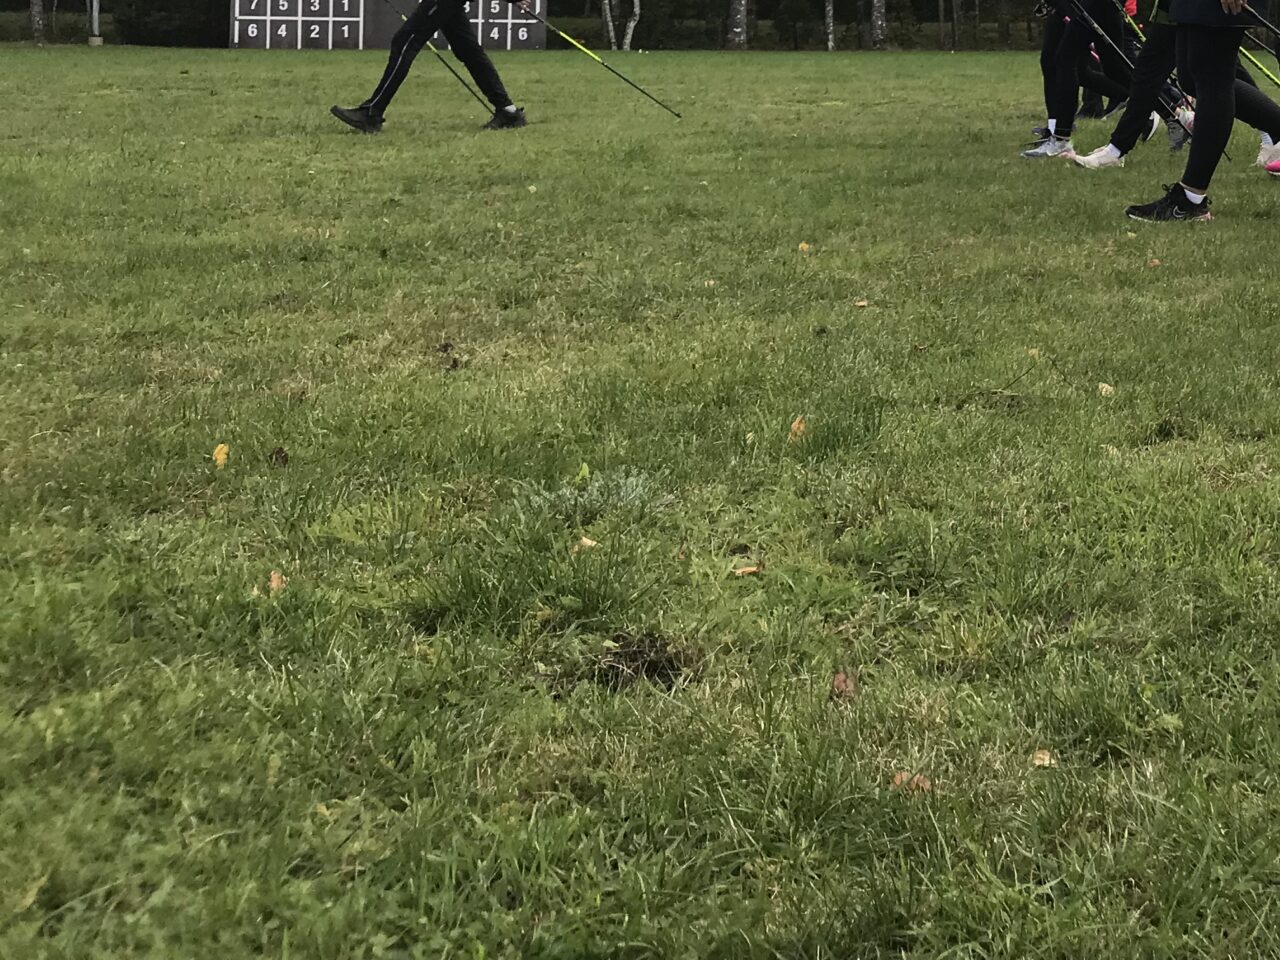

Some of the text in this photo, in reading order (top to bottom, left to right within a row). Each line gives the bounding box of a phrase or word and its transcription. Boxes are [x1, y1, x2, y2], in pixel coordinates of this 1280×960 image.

[342, 0, 349, 11] 1
[491, 1, 500, 13] 5
[248, 24, 528, 40] 6 4 2 1 4 6
